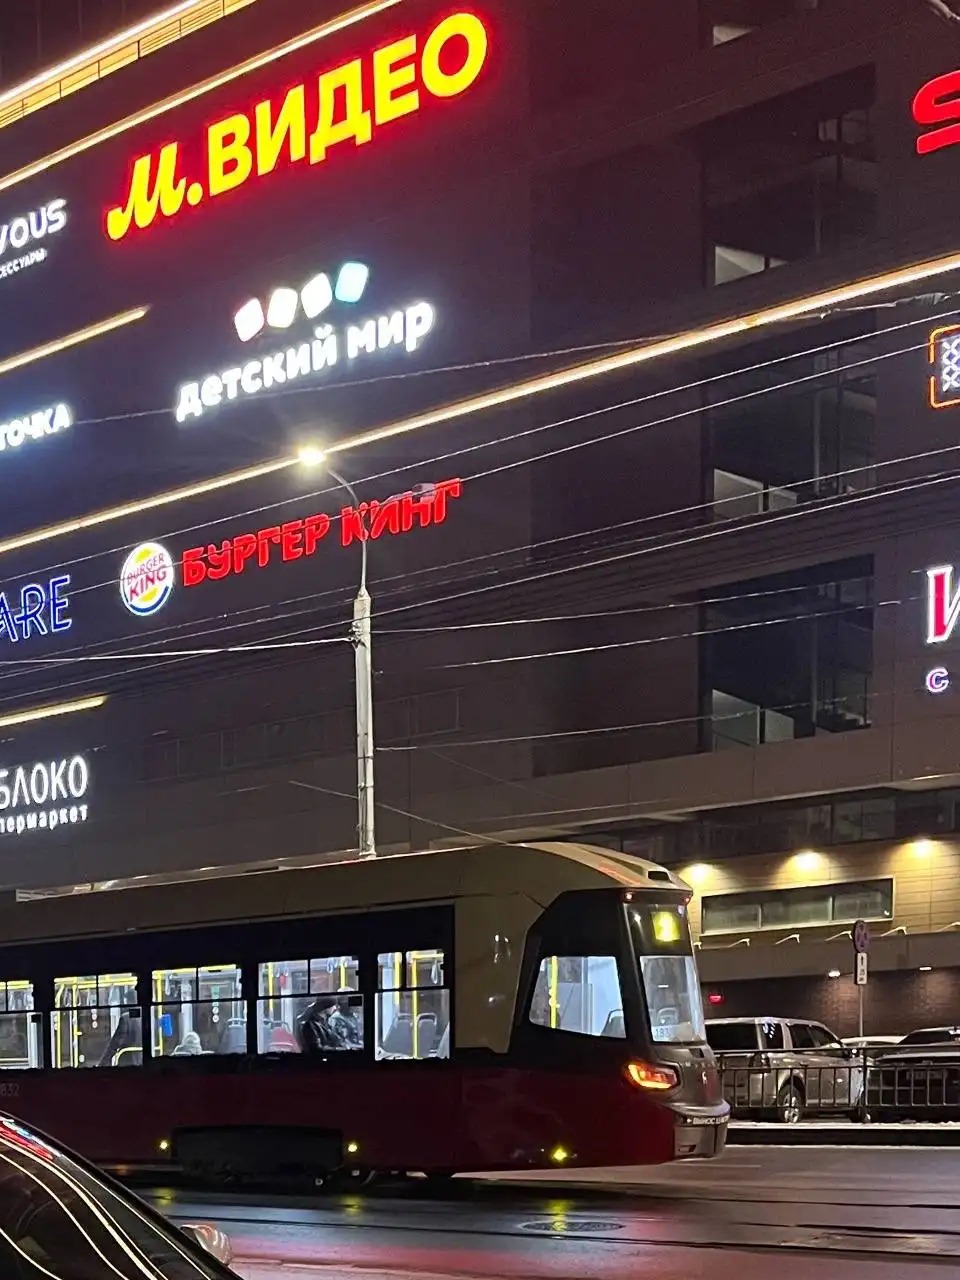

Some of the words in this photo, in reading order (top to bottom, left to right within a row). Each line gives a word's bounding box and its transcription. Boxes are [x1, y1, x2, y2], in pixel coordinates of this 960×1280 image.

[175, 323, 337, 423] детский
[347, 301, 434, 360] мир
[182, 513, 330, 586] БУРГЕР
[342, 478, 461, 546] КИНГ
[127, 552, 164, 585] BURGER
[129, 570, 166, 602] KING
